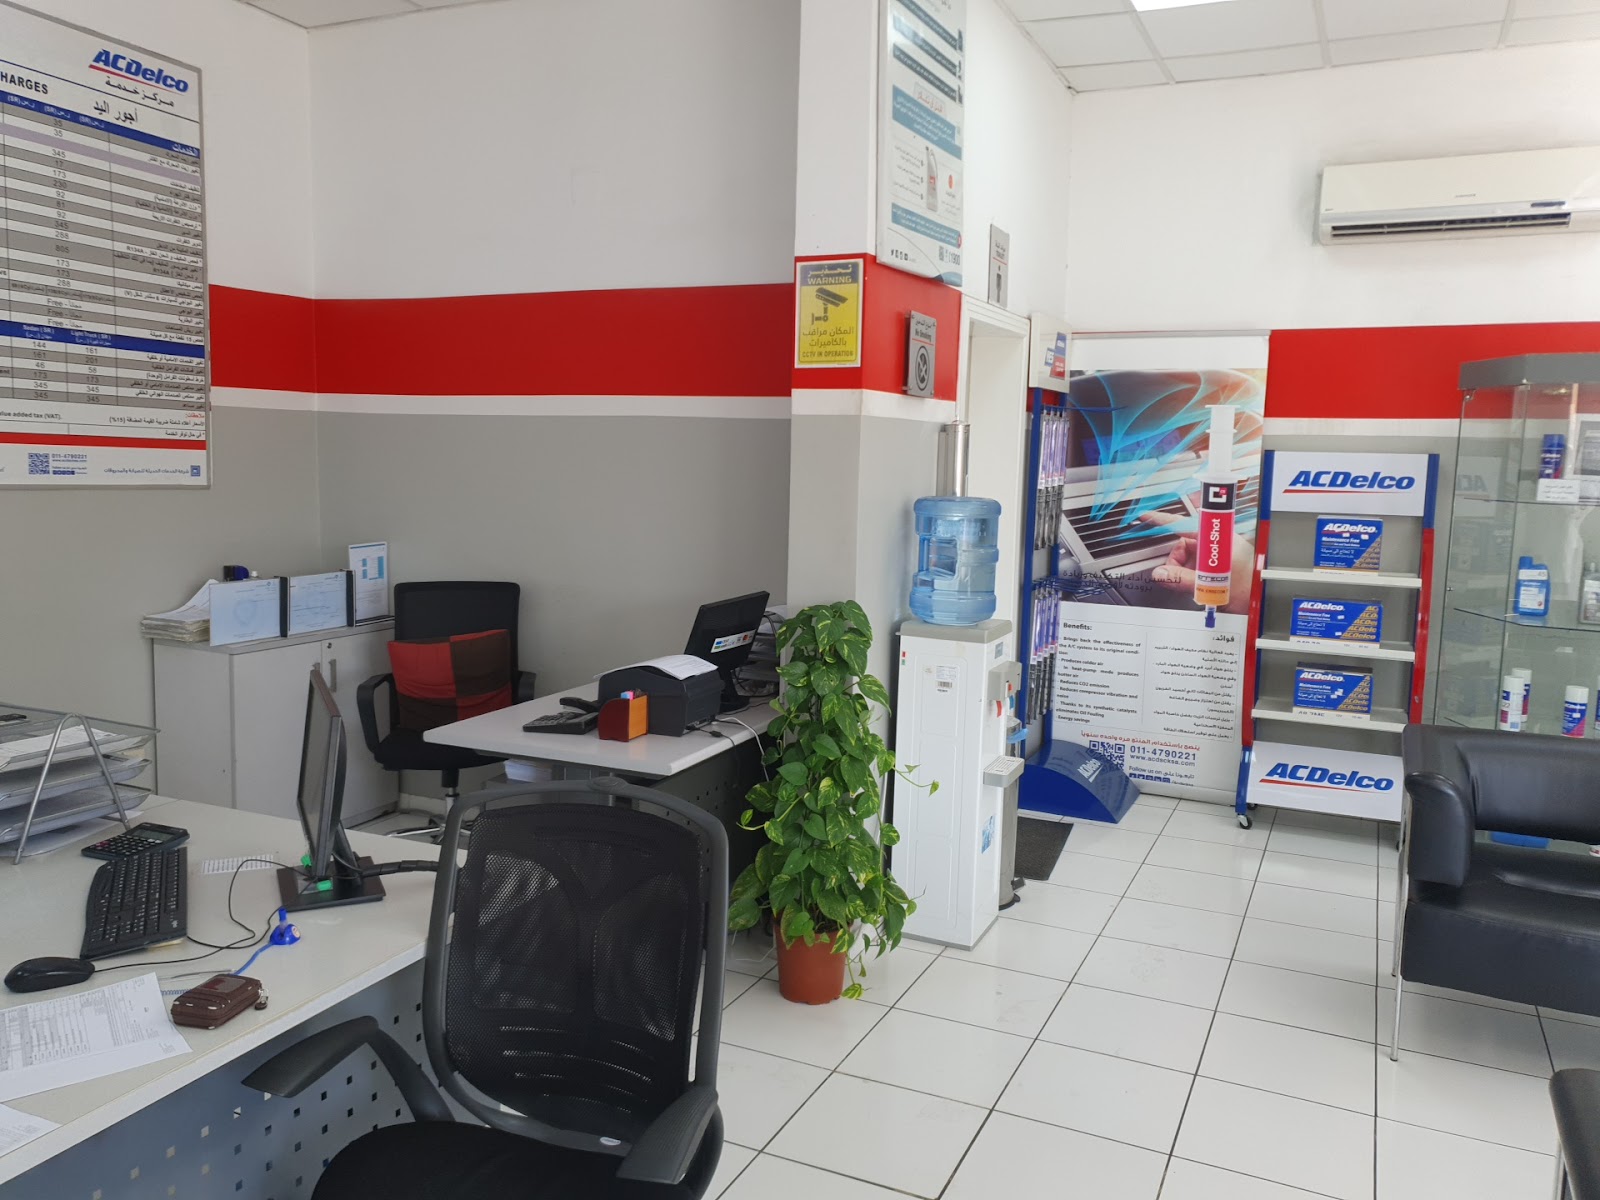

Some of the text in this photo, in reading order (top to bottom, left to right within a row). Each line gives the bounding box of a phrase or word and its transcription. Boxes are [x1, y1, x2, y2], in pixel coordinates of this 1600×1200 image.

[92, 48, 189, 92] ACDelco
[106, 76, 174, 107] مركز خدمة
[114, 108, 138, 124] أجور
[54, 128, 63, 137] 35
[52, 148, 66, 158] 345
[52, 170, 66, 178] 173
[56, 190, 66, 198] 92
[56, 211, 66, 219] 92
[56, 260, 70, 268] 173
[56, 270, 70, 278] 173
[808, 264, 852, 277] تحذير
[808, 276, 852, 286] WARNING
[47, 298, 63, 306] Free
[48, 308, 63, 316] Free
[48, 318, 63, 327] Free
[802, 326, 854, 338] المكان مراقب
[808, 338, 847, 348] بالكاميرات
[34, 382, 48, 390] 345
[1288, 470, 1416, 490] ACDelco
[1323, 522, 1376, 533] ACDelco
[1208, 518, 1220, 566] Cool-Shot
[1300, 601, 1344, 611] ACDelco
[1064, 622, 1092, 630] Benefits:
[1300, 672, 1344, 682] ACDelco
[1130, 745, 1197, 761] 011-4790221
[1266, 762, 1394, 791] ACDelco
